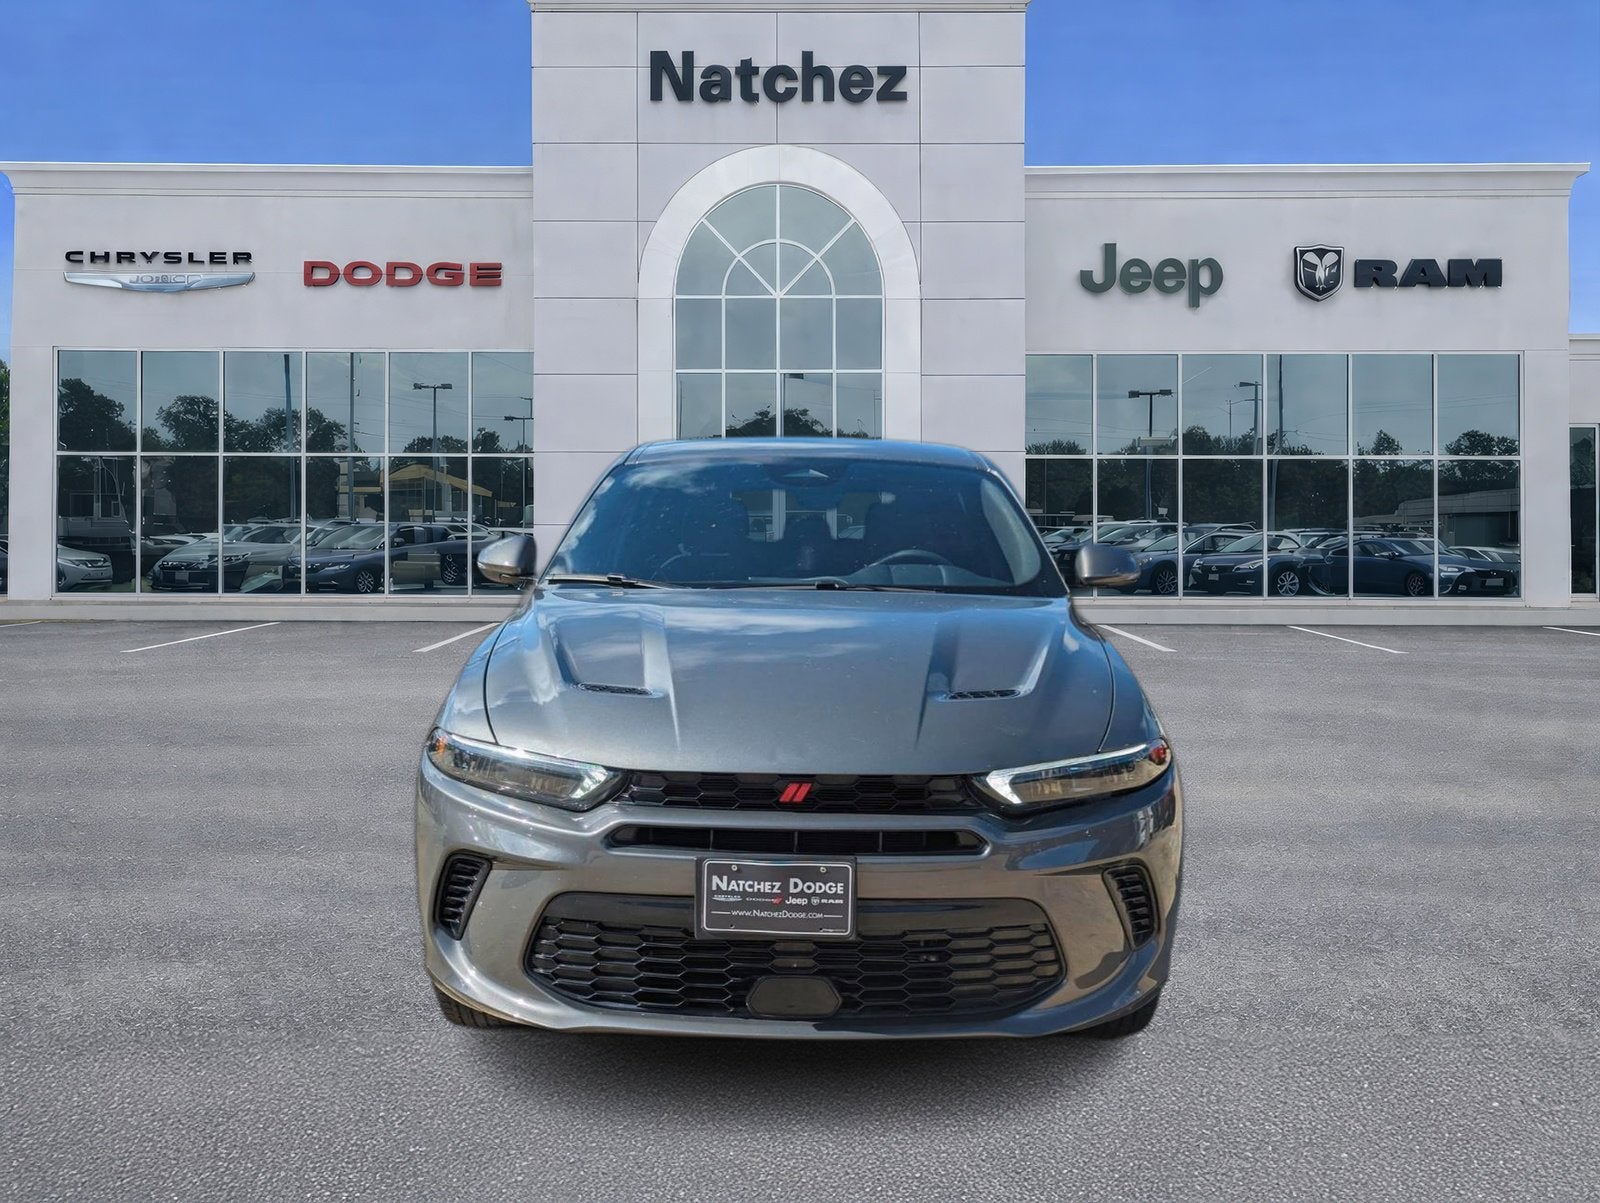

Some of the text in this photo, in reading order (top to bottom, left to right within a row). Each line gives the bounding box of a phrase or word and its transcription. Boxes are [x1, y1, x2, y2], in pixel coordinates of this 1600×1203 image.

[650, 50, 907, 103] Natchez
[65, 251, 252, 265] CHRYSLER
[304, 260, 502, 287] DODGE
[1080, 243, 1224, 308] Jeep
[1354, 258, 1503, 288] RAM
[785, 896, 808, 905] Jeep
